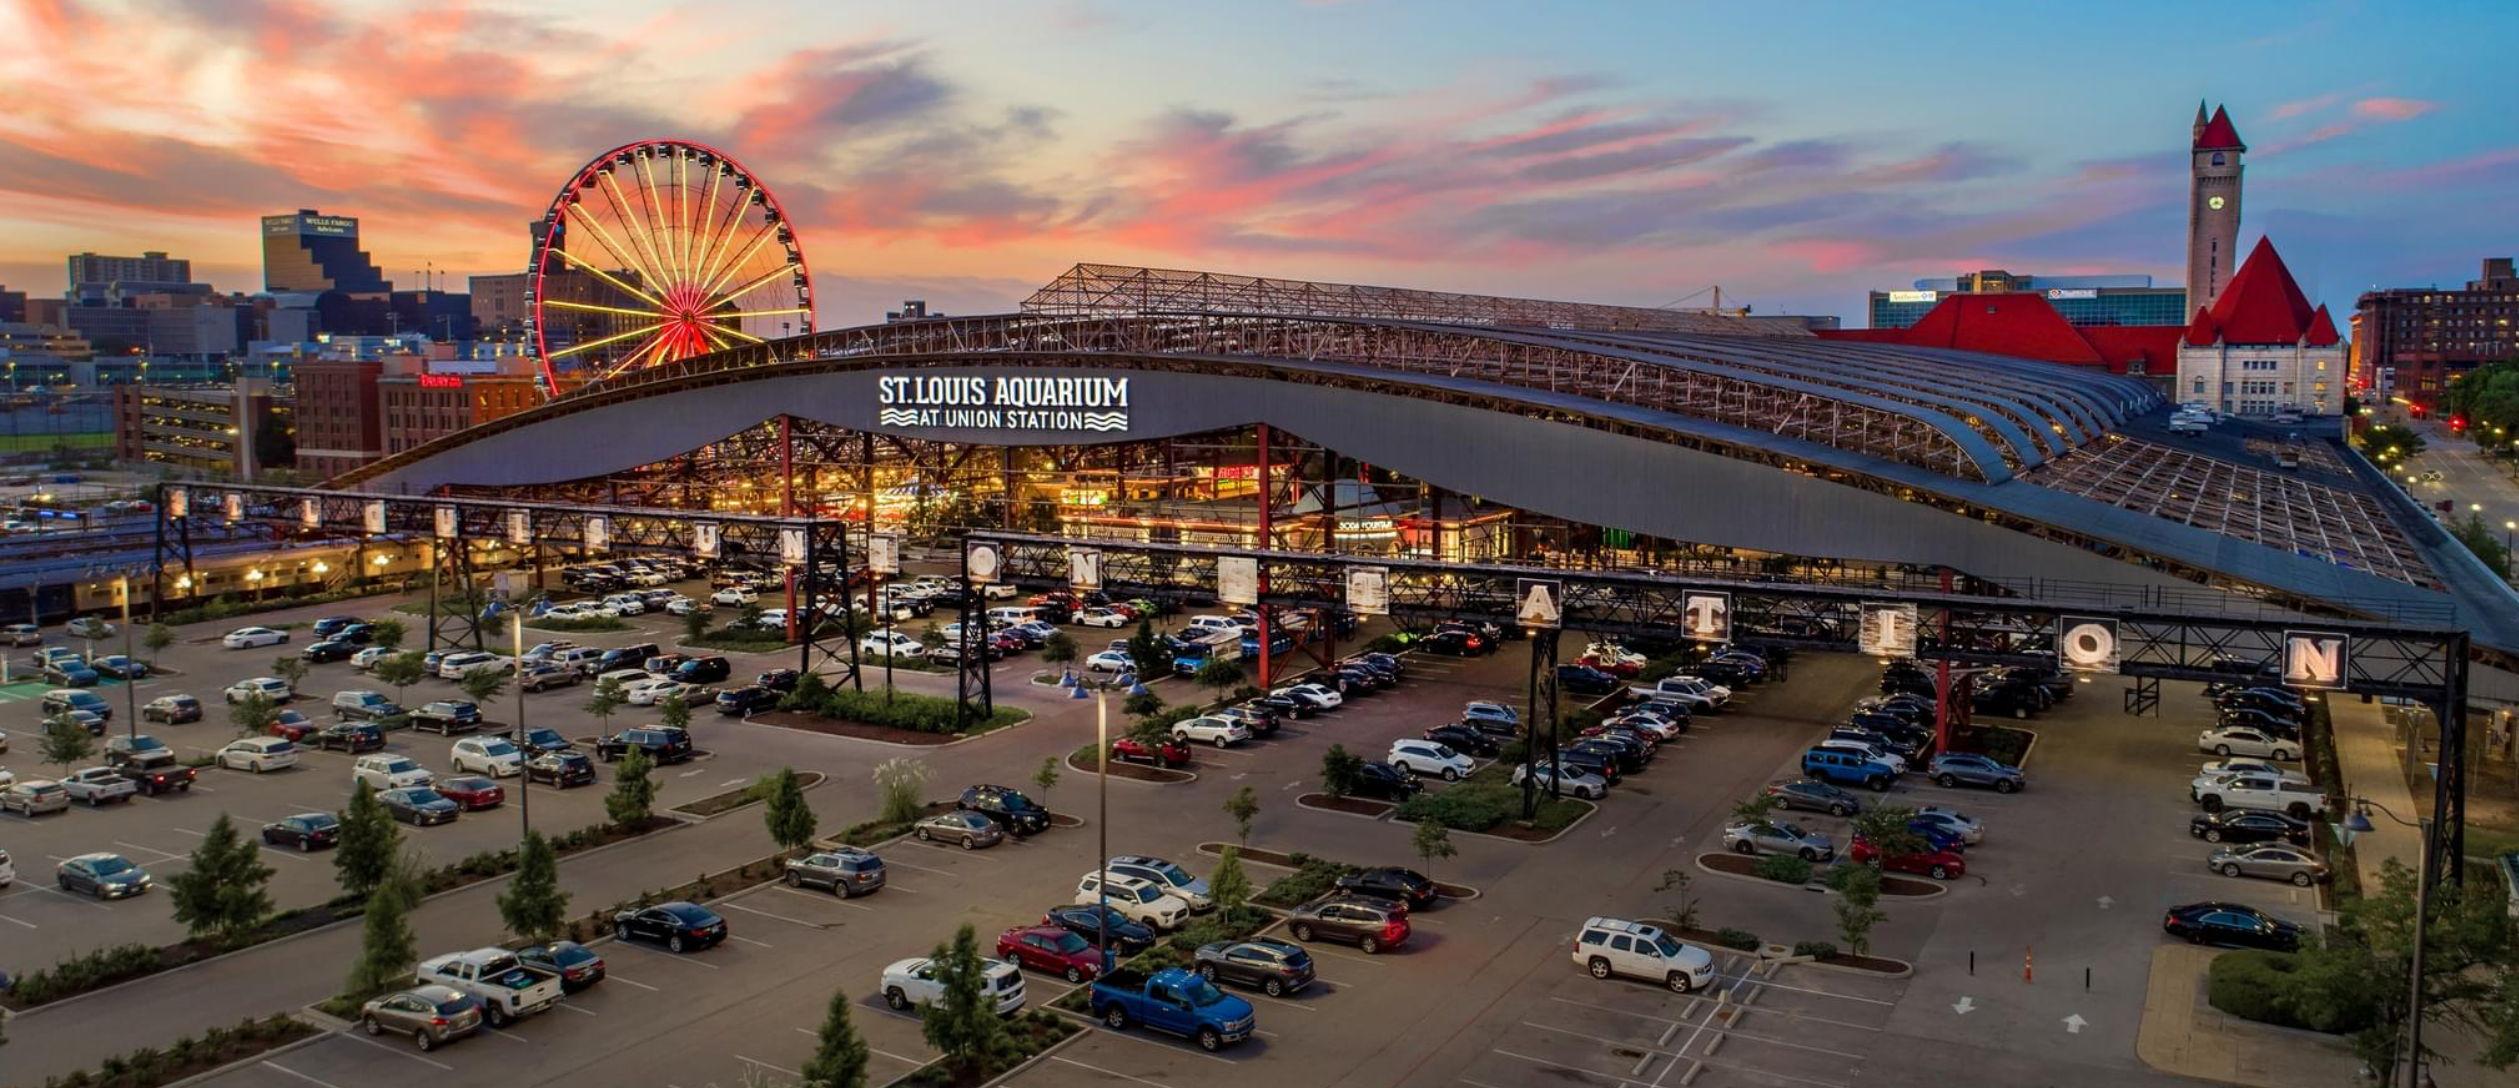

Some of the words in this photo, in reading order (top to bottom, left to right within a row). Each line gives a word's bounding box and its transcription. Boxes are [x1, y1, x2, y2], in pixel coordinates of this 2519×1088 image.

[306, 217, 329, 226] WELLS
[331, 219, 354, 227] FARGO
[914, 377, 986, 406] LOUIS
[994, 377, 1129, 407] AQUARIUM
[919, 409, 940, 427] AT
[945, 410, 1000, 428] UNION
[1006, 411, 1083, 430] STATION
[1518, 584, 1559, 620] A
[1686, 596, 1726, 633] T
[2063, 623, 2113, 664] O
[2285, 637, 2341, 680] N
